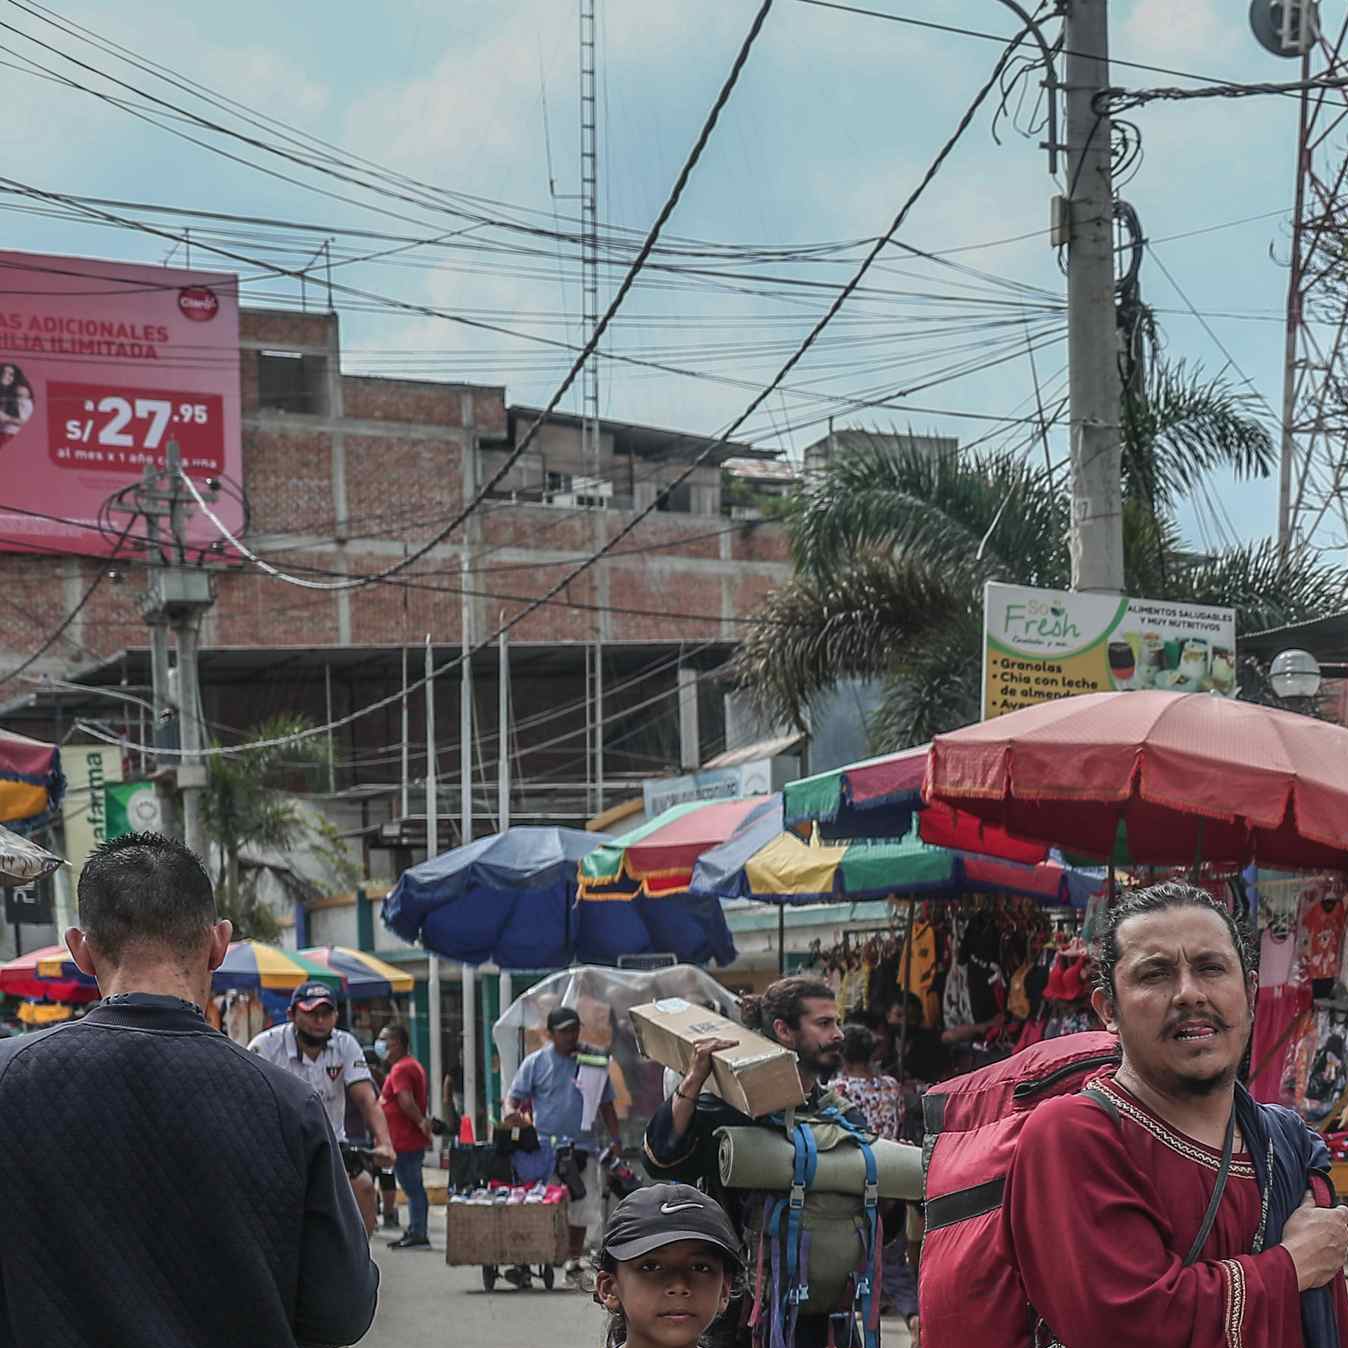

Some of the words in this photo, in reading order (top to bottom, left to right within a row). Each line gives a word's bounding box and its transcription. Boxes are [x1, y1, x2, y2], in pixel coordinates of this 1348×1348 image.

[28, 316, 169, 343] ADICIONALES
[50, 337, 159, 360] ILIMITADA
[75, 450, 103, 461] mes
[1004, 604, 1080, 638] Fresh
[1127, 606, 1177, 617] ALIMENTOS
[1178, 608, 1232, 622] SALUDABLES
[1140, 617, 1146, 625] Y
[1148, 618, 1167, 627] MUY
[1168, 619, 1221, 632] NUTRITIVOS
[1000, 658, 1062, 673] Granolas
[1000, 672, 1031, 684] Chia
[1034, 676, 1059, 687] con
[1062, 676, 1098, 690] leche
[1000, 686, 1017, 696] de
[1020, 688, 1078, 700] almend
